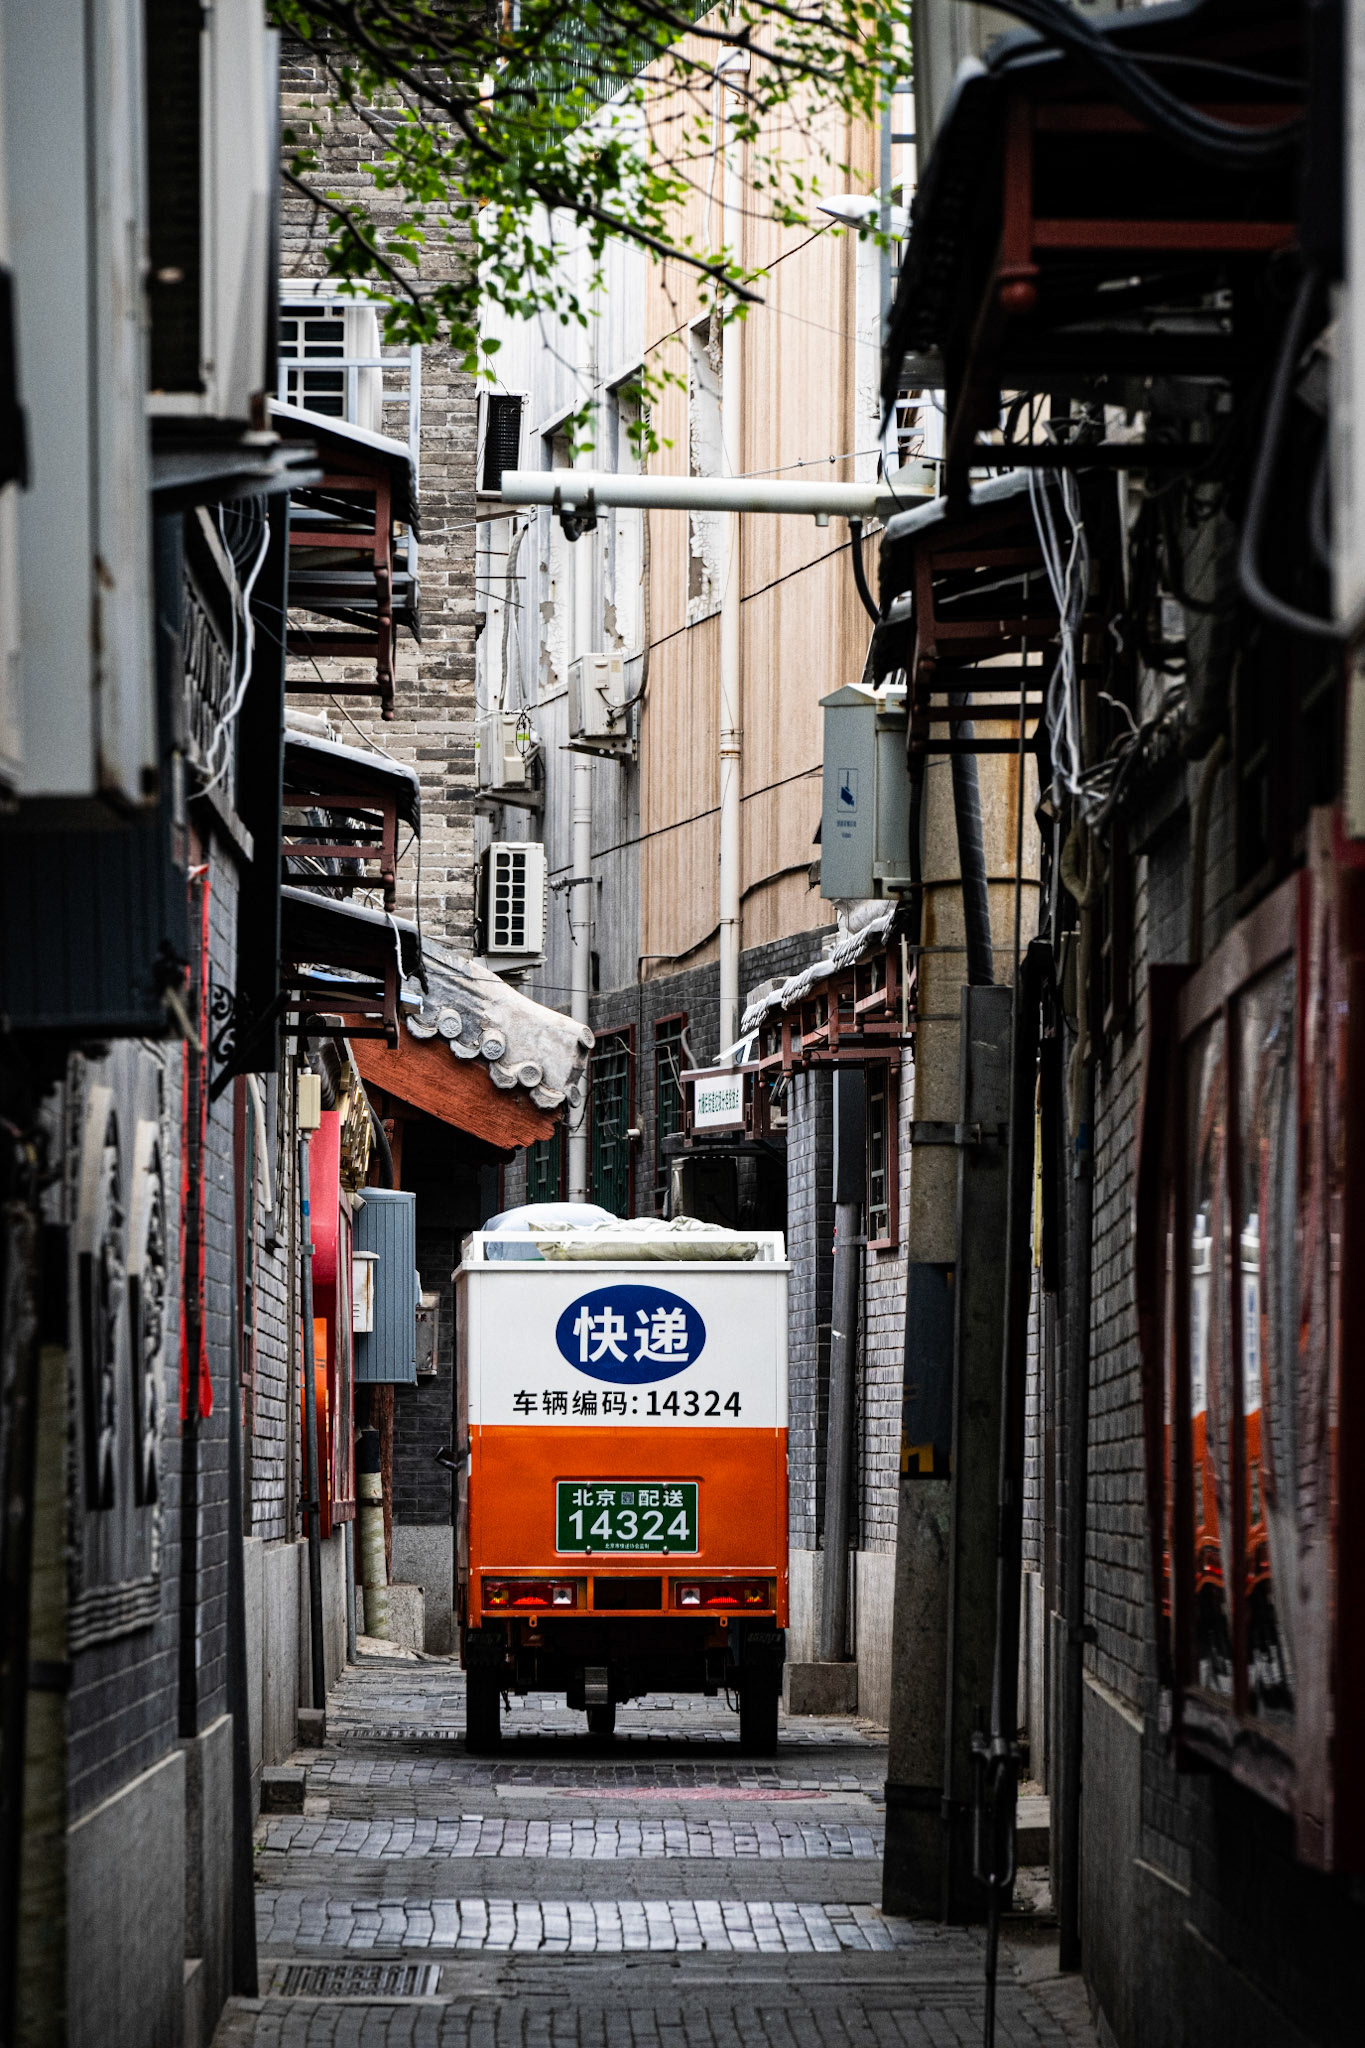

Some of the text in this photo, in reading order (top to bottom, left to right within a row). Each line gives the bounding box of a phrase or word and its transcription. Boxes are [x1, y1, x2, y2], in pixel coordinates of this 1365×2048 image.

[573, 1306, 690, 1362] 快递
[572, 1489, 684, 1507] 北京 配送
[568, 1509, 690, 1541] 14324
